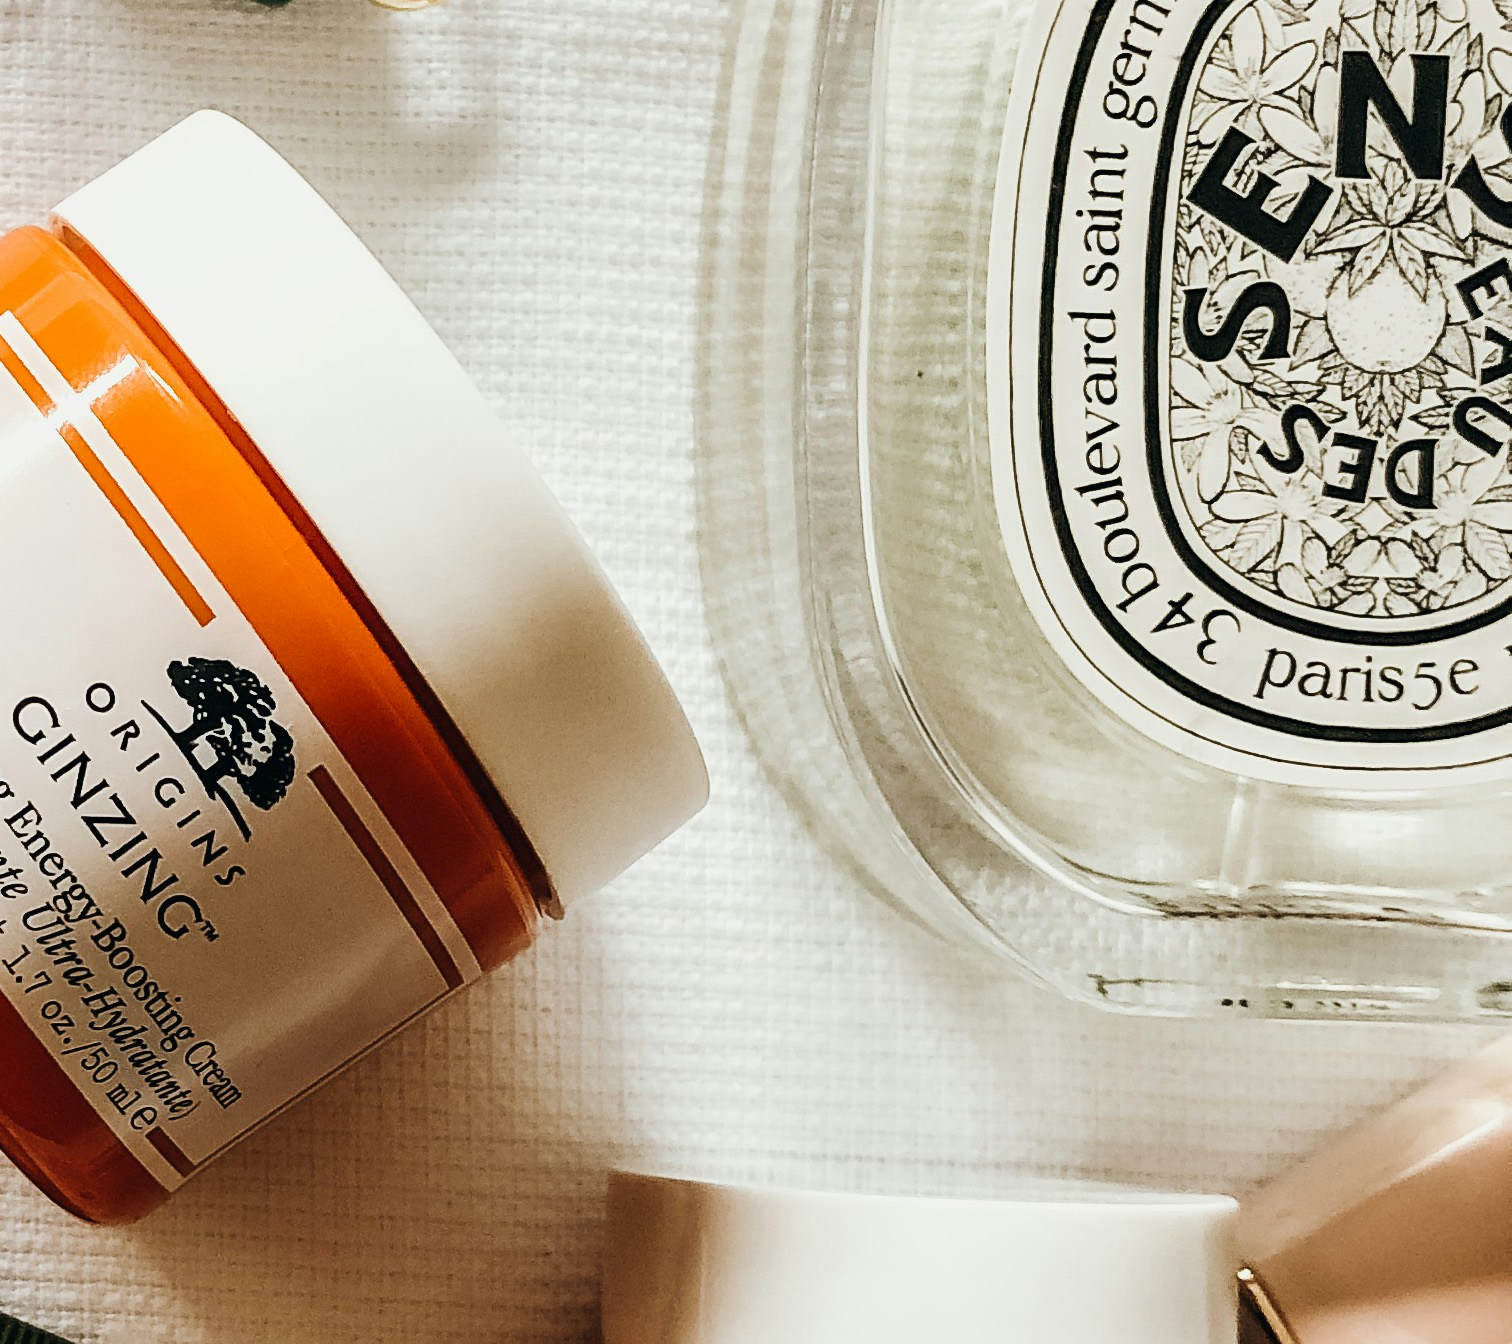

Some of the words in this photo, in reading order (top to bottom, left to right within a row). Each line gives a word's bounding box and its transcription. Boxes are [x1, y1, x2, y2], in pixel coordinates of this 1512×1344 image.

[1076, 144, 1128, 292] saint
[1067, 310, 1160, 614] boulevard
[1257, 404, 1439, 510] DES
[1151, 592, 1241, 664] 34
[86, 682, 246, 885] ORIGINS
[2, 944, 52, 993] 1.7
[41, 1001, 118, 1083] oz./50
[4, 800, 195, 1052] Energy-Boosting
[185, 1040, 242, 1109] Cream
[23, 902, 201, 1121] Ultra-Hydratante)
